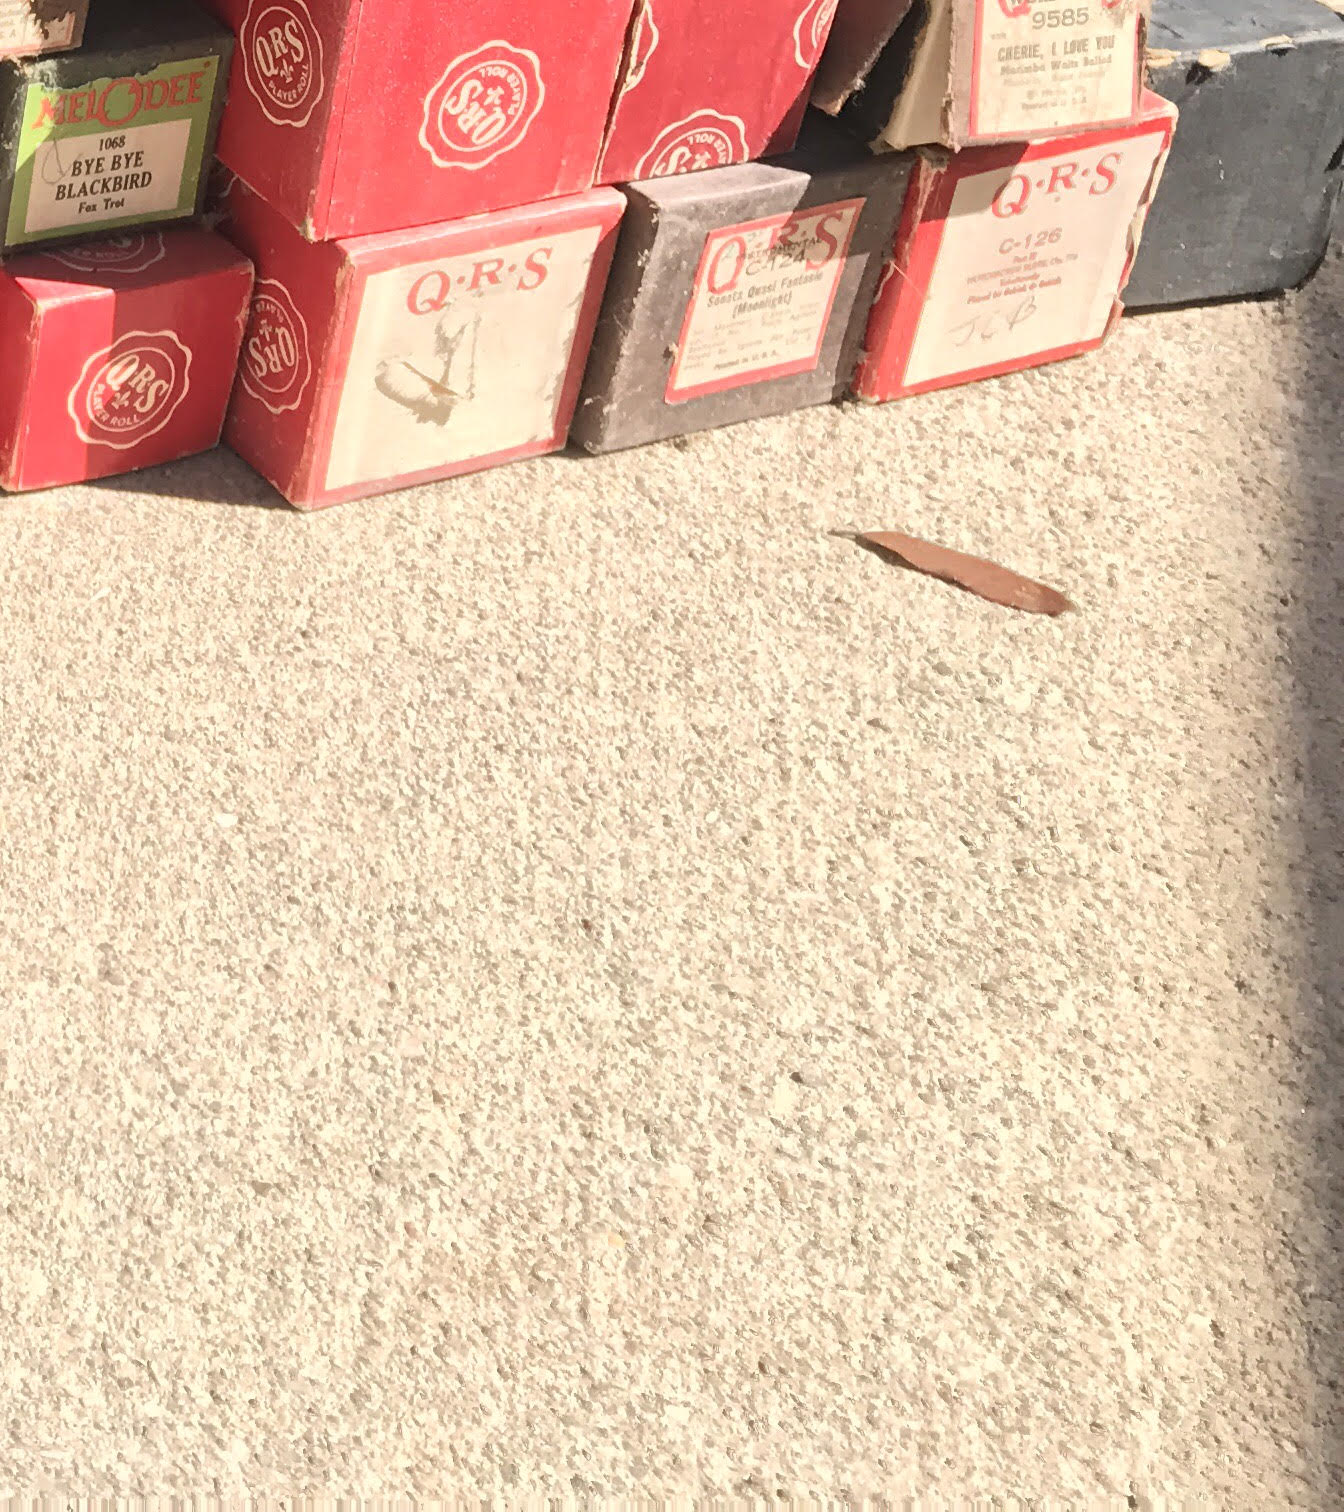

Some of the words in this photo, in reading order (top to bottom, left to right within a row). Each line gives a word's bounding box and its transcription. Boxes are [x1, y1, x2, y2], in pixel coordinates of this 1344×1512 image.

[1032, 7, 1090, 29] 9585
[32, 71, 207, 129] MELODEE
[99, 136, 126, 151] 1068
[71, 157, 106, 177] BYE
[111, 151, 145, 170] BYE
[55, 172, 152, 201] BLACKBIRD
